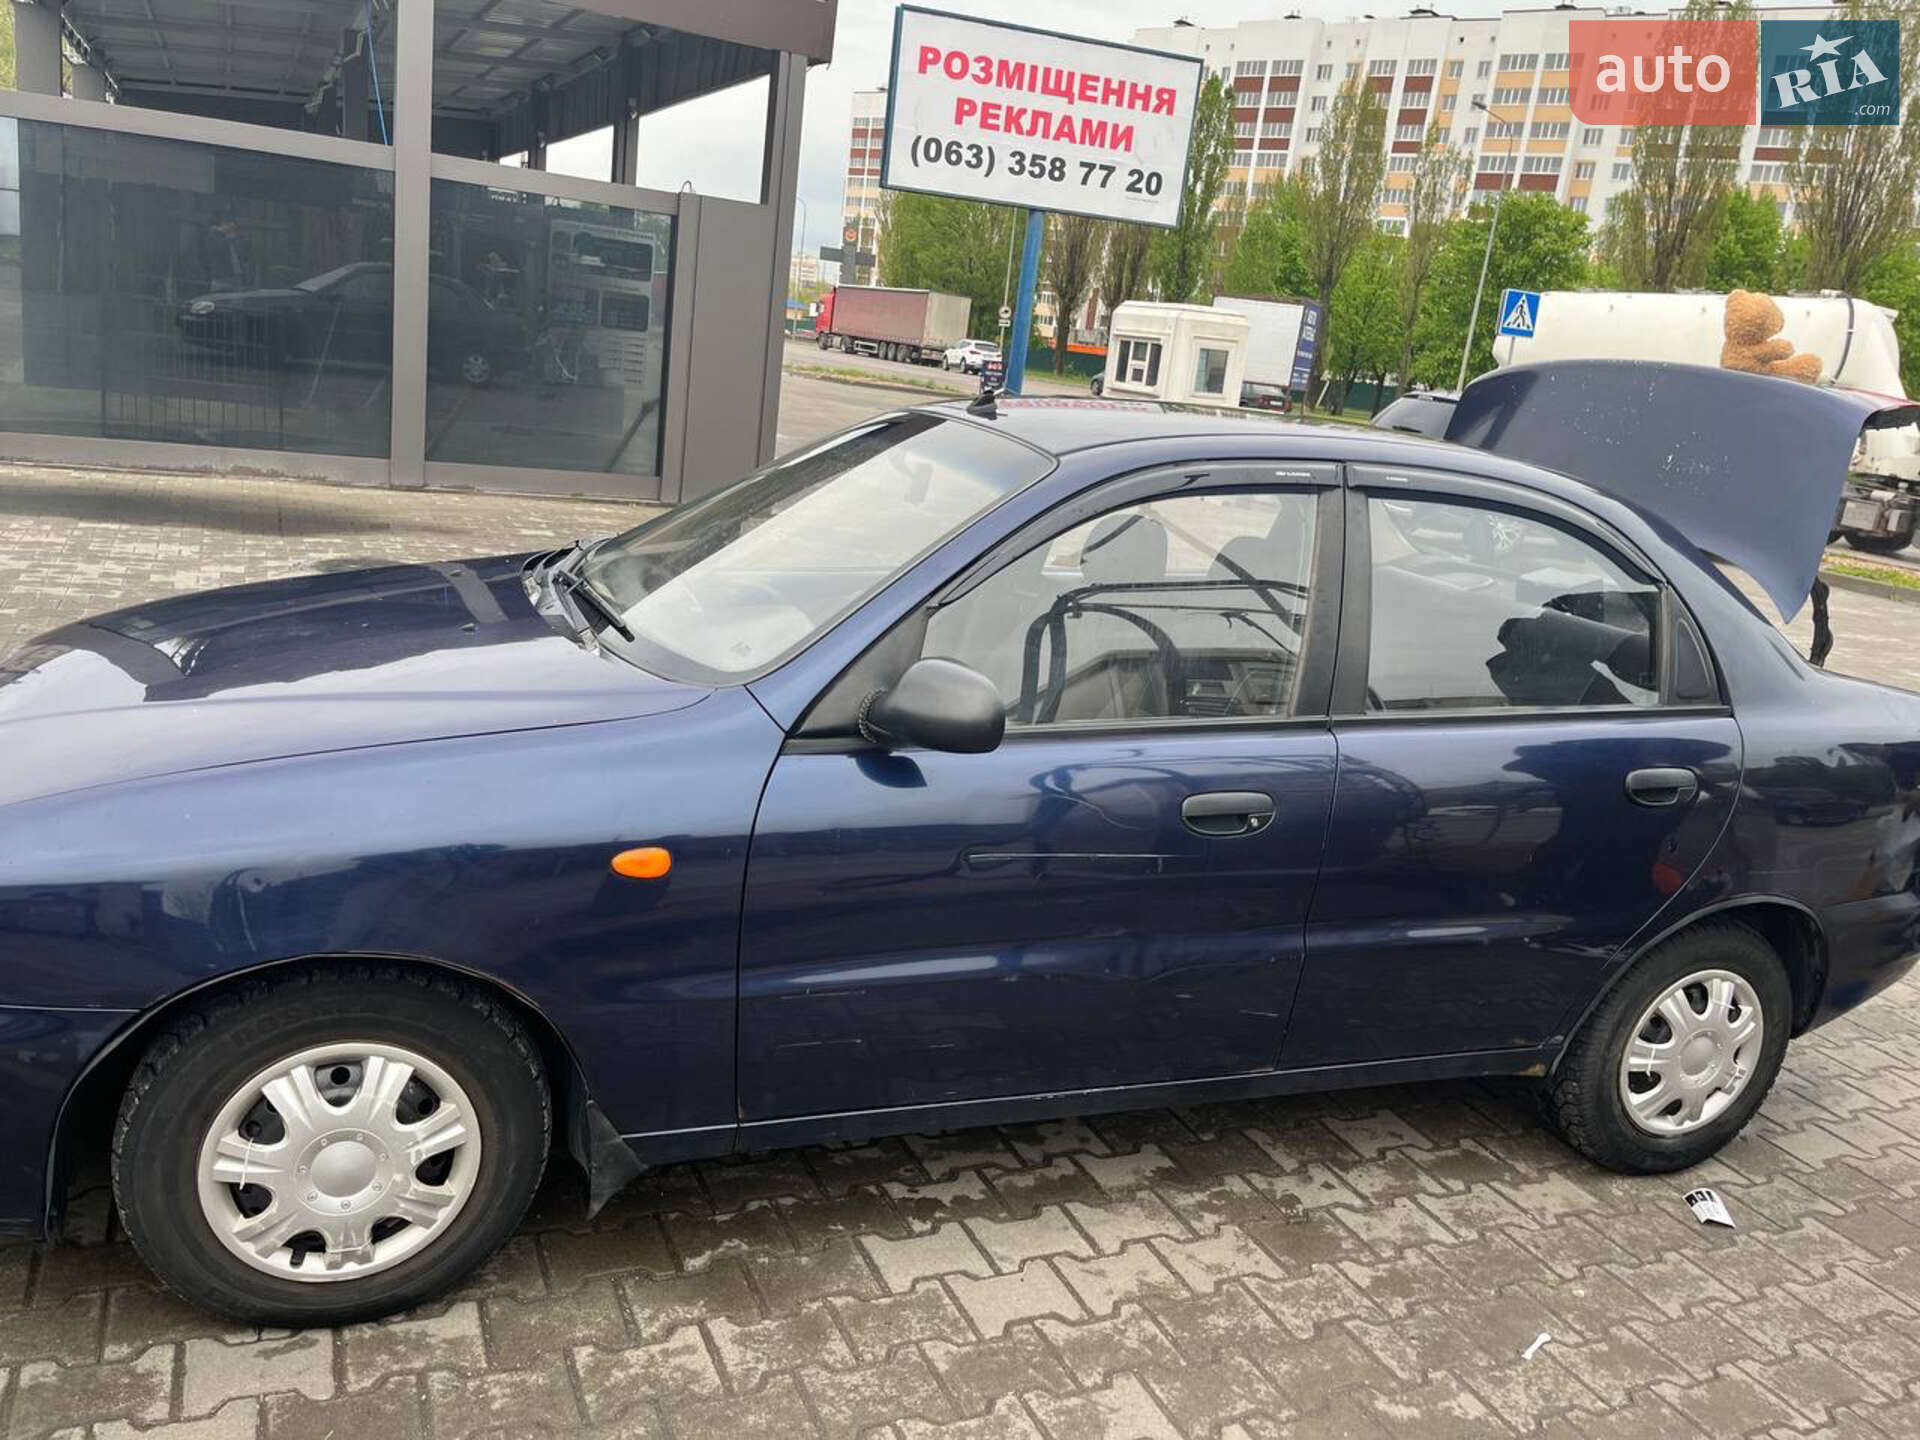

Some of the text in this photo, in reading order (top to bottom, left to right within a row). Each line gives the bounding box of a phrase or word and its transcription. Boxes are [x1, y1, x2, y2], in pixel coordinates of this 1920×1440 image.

[917, 45, 1177, 117] РОЗМІЩЕННЯ
[953, 95, 1135, 153] РЕКЛАМИ
[911, 135, 1163, 196] (063) 358 77 20
